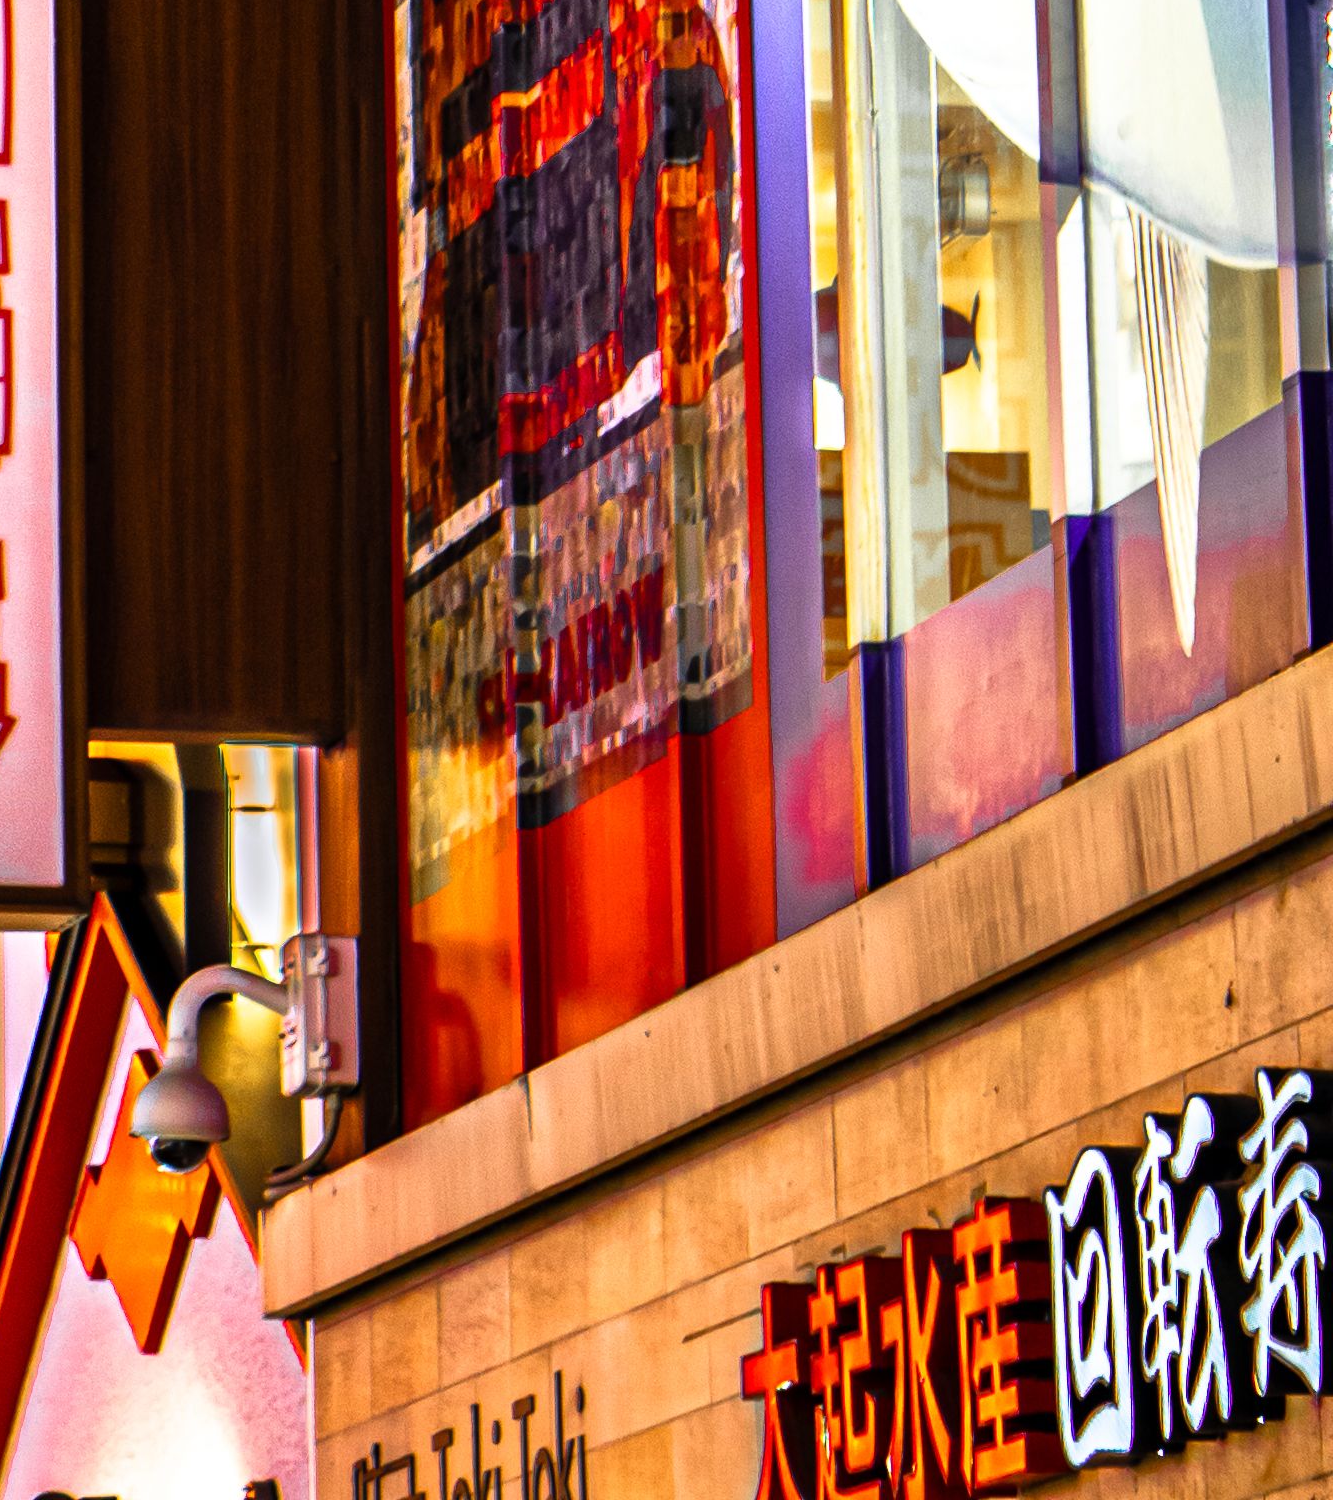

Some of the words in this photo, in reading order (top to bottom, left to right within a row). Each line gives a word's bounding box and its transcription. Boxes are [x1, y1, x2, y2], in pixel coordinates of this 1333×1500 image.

[741, 1196, 1043, 1500] 大起水産
[1043, 1066, 1325, 1470] 回転寿
